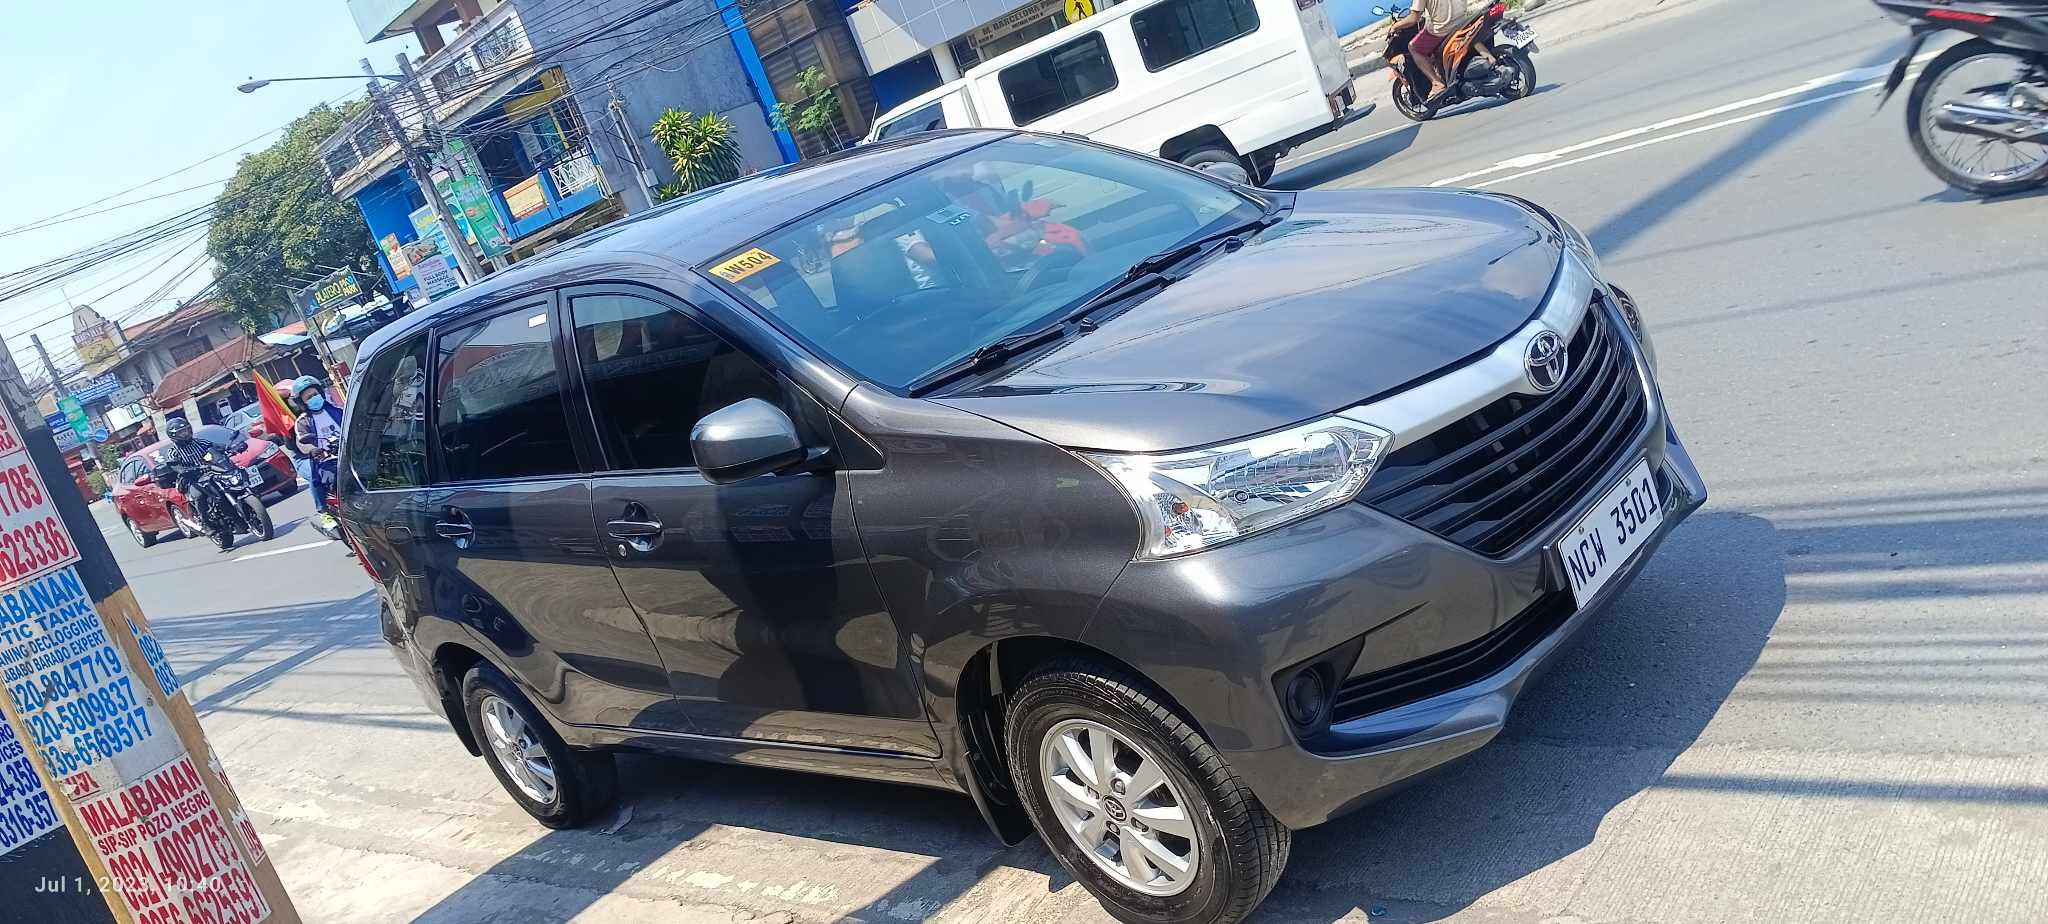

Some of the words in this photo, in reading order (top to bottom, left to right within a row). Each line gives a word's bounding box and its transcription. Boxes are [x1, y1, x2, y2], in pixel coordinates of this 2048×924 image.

[724, 252, 771, 275] W504
[314, 282, 341, 303] PLATERO
[1568, 528, 1606, 591] NCW
[1610, 478, 1657, 545] 3501
[29, 614, 99, 654] DECLOGGING
[34, 599, 91, 631] TANK
[33, 645, 71, 671] BARADO
[72, 629, 107, 656] EXPERT
[80, 757, 201, 837] MALABANAN
[97, 828, 138, 856] SIP-SIP
[137, 812, 172, 841] POZO
[170, 790, 211, 823] NEGRO
